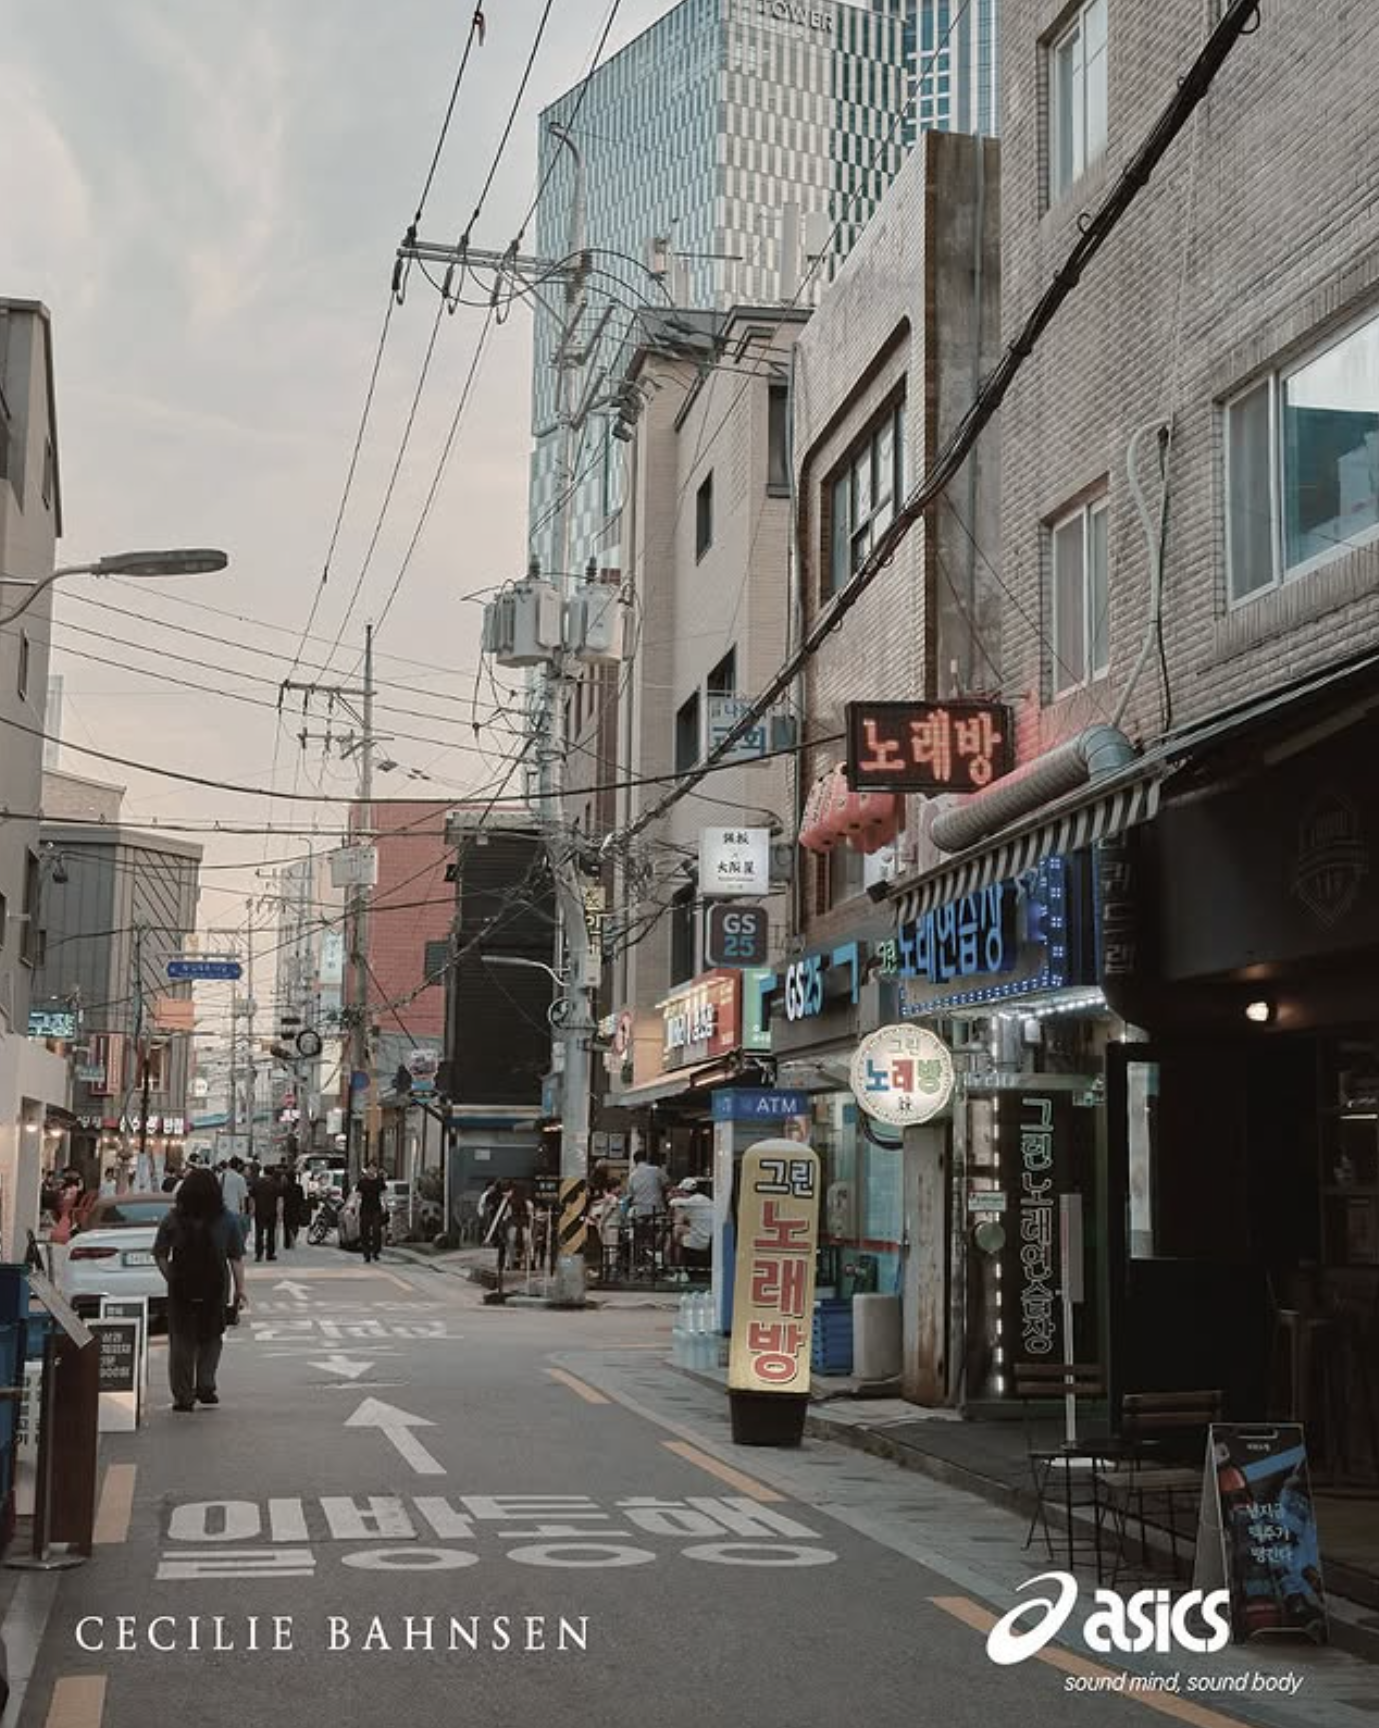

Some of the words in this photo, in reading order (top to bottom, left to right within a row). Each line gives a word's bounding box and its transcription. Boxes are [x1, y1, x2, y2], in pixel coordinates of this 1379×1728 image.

[859, 708, 1002, 785] 노래방
[723, 913, 757, 935] GS
[899, 881, 1004, 984] 노래연습장
[724, 935, 756, 957] 25
[785, 953, 823, 1021] GS25
[887, 1038, 920, 1056] 그린
[865, 1058, 942, 1095] 노래방
[756, 1097, 798, 1113] ATM
[755, 1159, 814, 1199] 그린
[748, 1200, 812, 1385] 노래방
[155, 1495, 840, 1581] 일방통행
